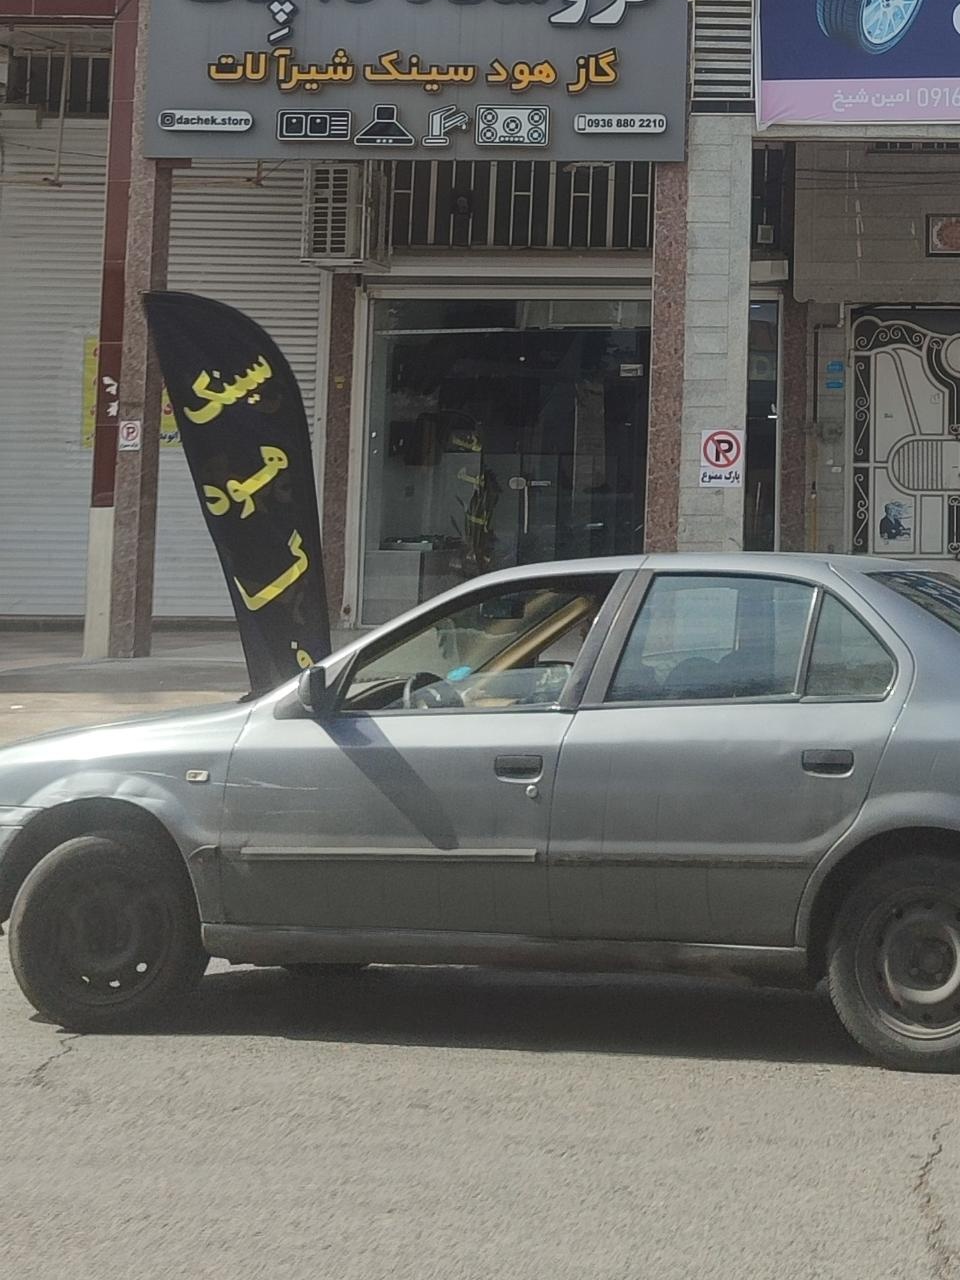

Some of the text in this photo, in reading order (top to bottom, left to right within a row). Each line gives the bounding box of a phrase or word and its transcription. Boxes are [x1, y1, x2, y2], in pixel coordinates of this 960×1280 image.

[363, 51, 476, 92] سینک
[486, 57, 557, 92] هود
[567, 48, 617, 93] گاز
[832, 87, 869, 112] شیخ
[871, 88, 911, 108] امین
[587, 118, 665, 129] 0936 880 2210
[184, 356, 272, 424] سینک
[203, 445, 289, 520] هود
[701, 471, 740, 484] پارک ممنوع
